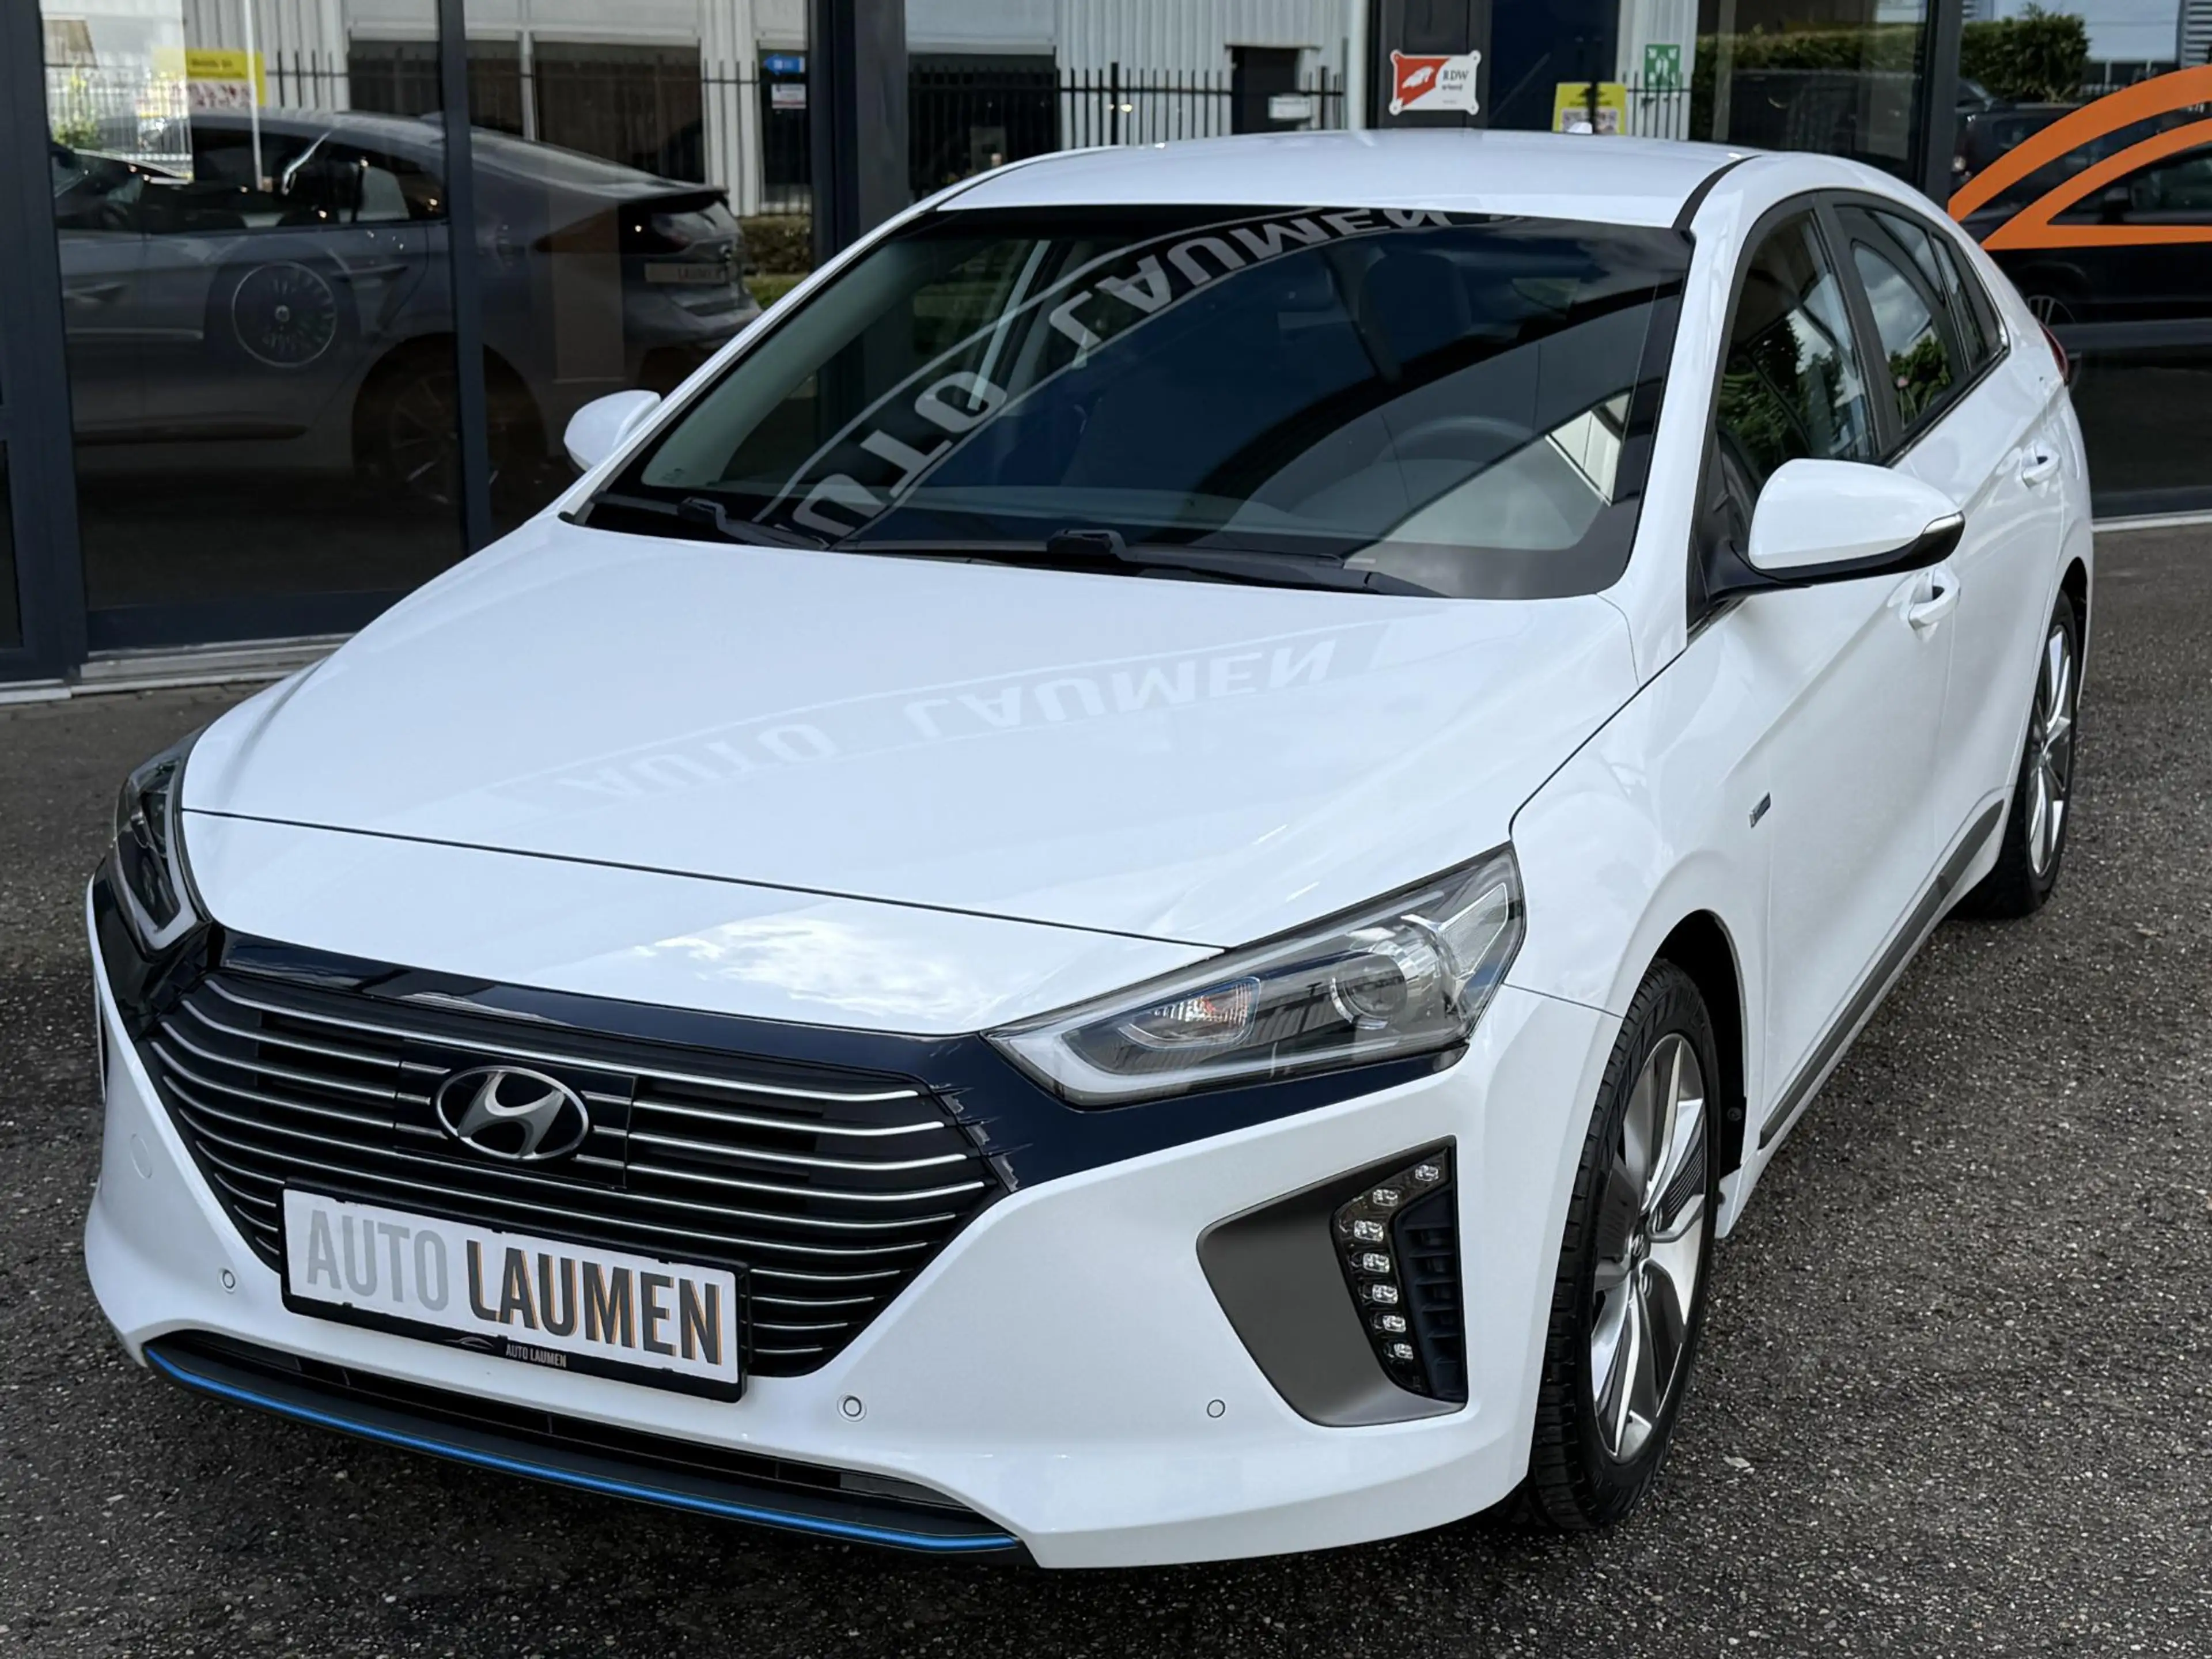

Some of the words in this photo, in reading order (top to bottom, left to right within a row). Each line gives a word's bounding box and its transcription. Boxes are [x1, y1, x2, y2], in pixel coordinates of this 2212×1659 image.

[1442, 70, 1469, 81] RDW
[308, 1210, 448, 1311] AUTO
[467, 1240, 722, 1366] LAUMEN
[506, 1344, 528, 1359] AUTO
[531, 1348, 566, 1367] LAUMEN
